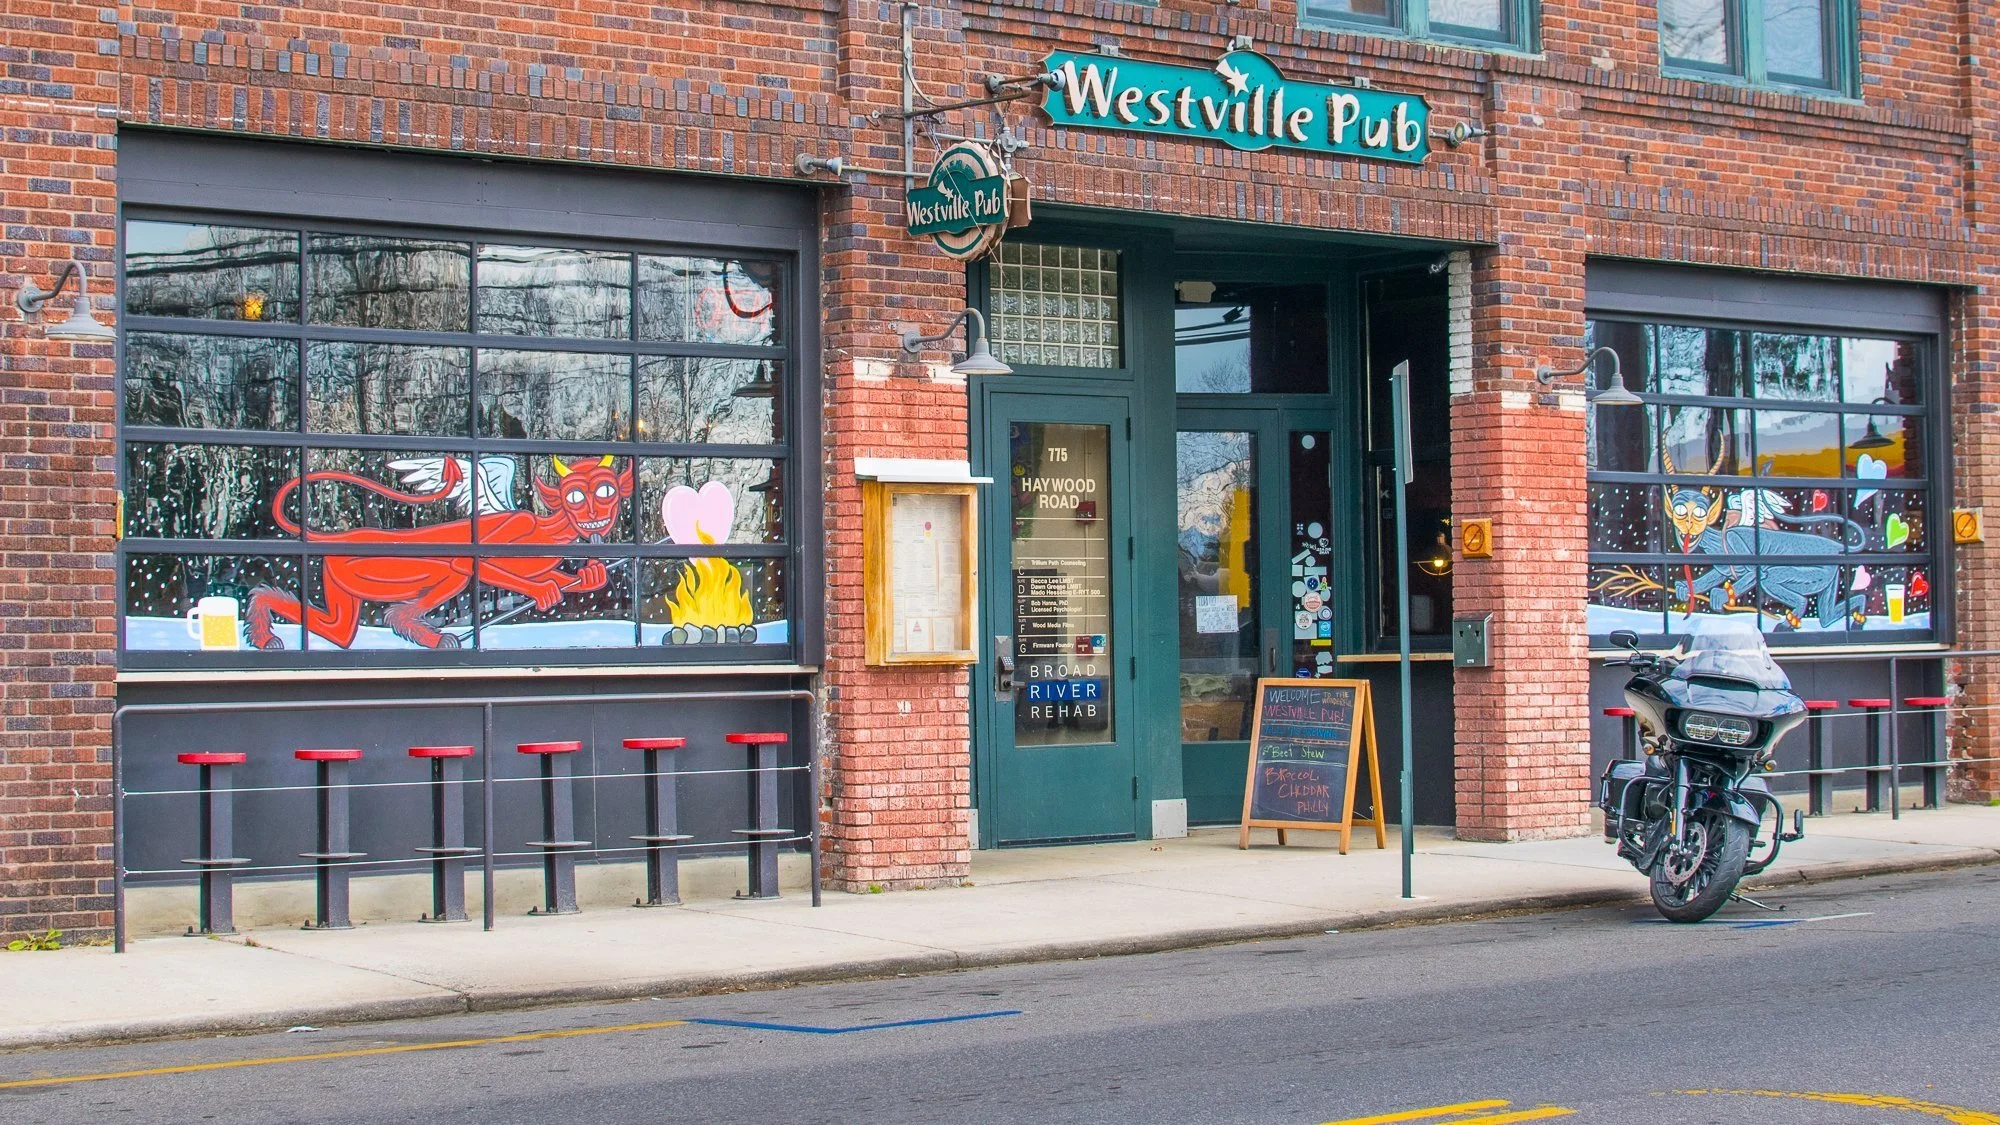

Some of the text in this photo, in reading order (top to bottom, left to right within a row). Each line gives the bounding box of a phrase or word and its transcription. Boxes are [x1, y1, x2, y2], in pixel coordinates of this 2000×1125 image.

[1064, 60, 1421, 151] Westville Pub
[906, 188, 1001, 227] Westville Pub
[1048, 447, 1068, 462] 775
[1022, 477, 1096, 493] HAYWOOD
[1039, 494, 1080, 509] ROAD
[1018, 565, 1025, 576] C
[1018, 584, 1025, 594] D
[1019, 604, 1025, 615] E
[1020, 624, 1025, 634] F
[1020, 643, 1027, 654] G
[1055, 642, 1075, 650] Foundry
[1030, 664, 1096, 678] BROAD
[1030, 683, 1097, 699] RIVER
[1269, 688, 1320, 705] WELCOME
[1031, 704, 1097, 719] REHAB
[1264, 705, 1345, 723] WESTVILLE PUB!
[1271, 743, 1325, 759] Beef Stew
